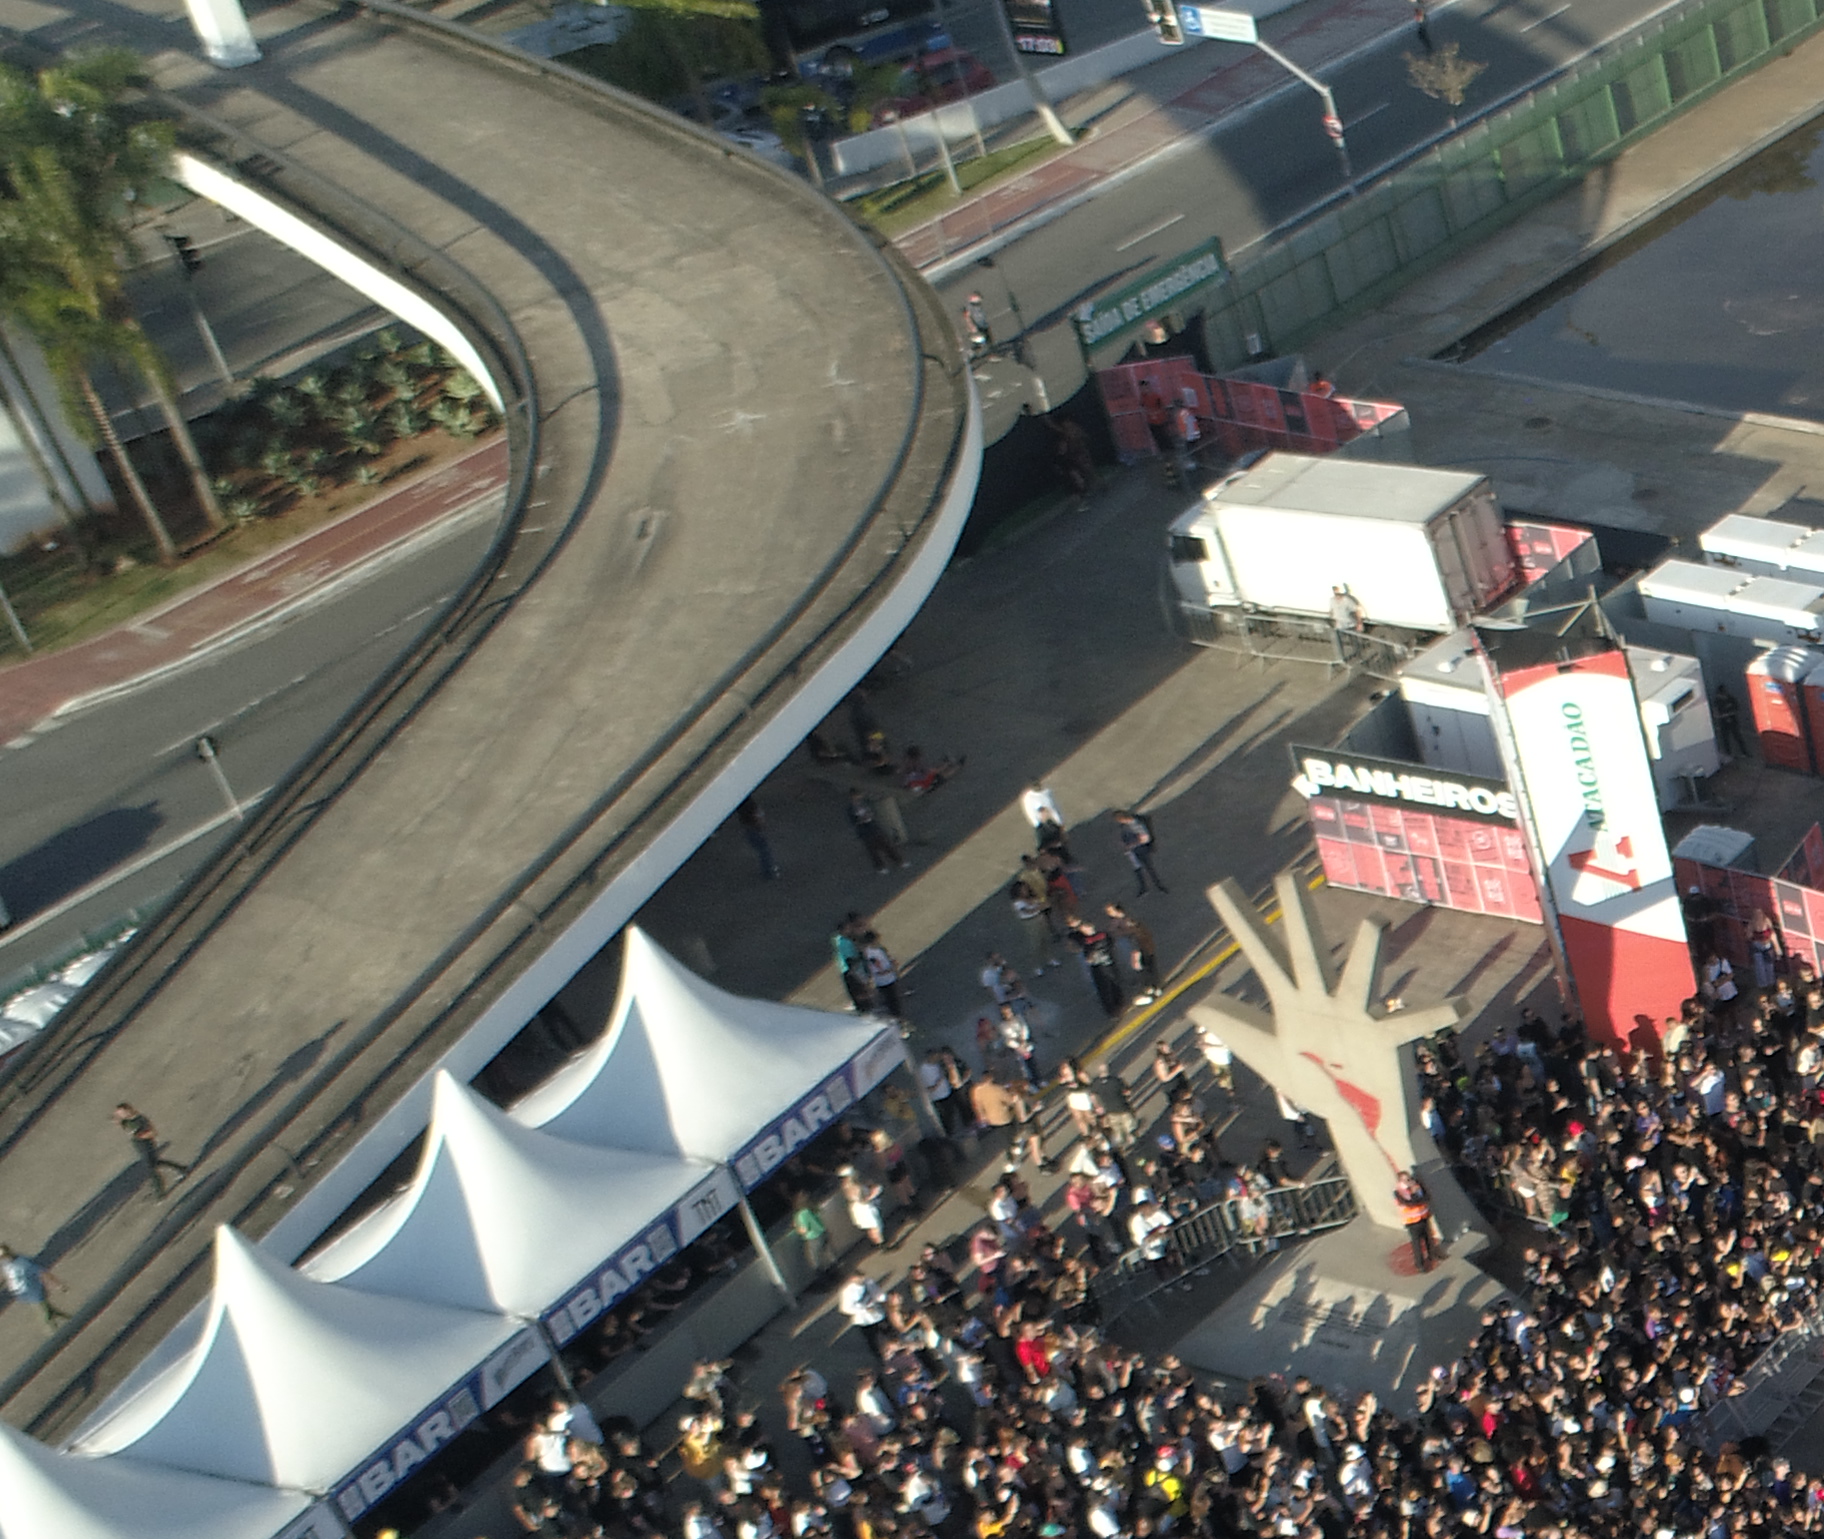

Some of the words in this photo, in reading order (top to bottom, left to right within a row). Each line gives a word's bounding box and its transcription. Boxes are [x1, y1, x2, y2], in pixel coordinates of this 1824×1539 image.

[1121, 297, 1143, 321] DE
[1302, 758, 1518, 820] BANHEIROS
[753, 1094, 834, 1174] BAR
[691, 1187, 724, 1225] TNT
[568, 1243, 655, 1330] BAR
[357, 1410, 457, 1502] BAR
